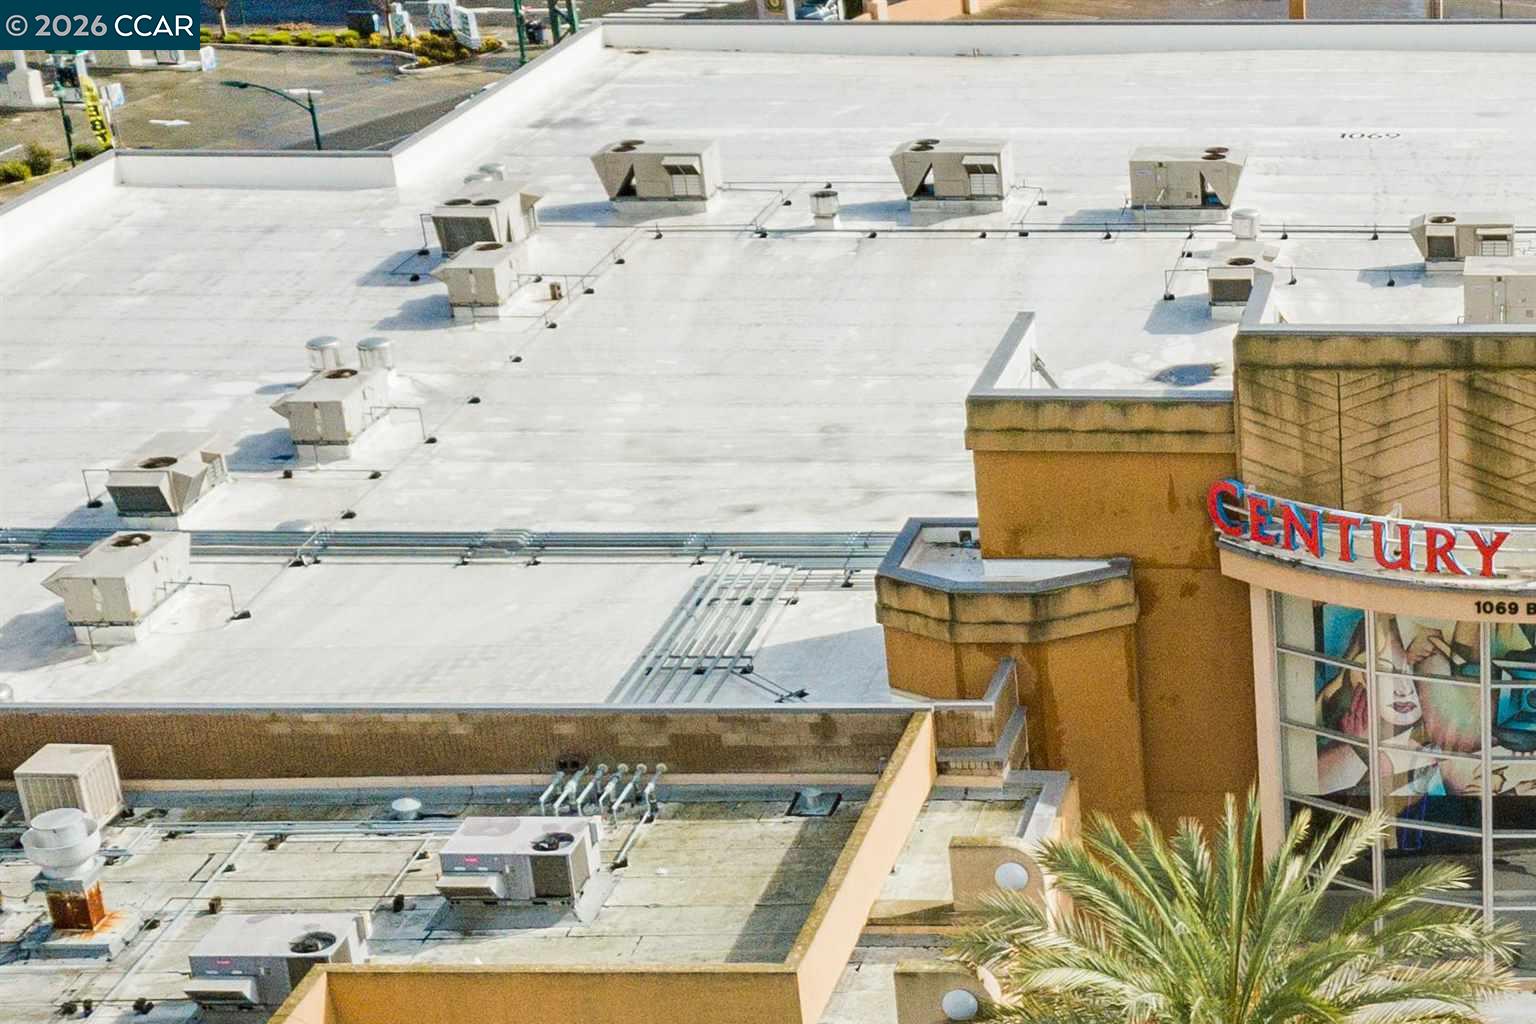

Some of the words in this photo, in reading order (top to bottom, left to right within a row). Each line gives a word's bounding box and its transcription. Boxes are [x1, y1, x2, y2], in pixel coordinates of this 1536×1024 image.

[1339, 131, 1401, 140] 1069
[1207, 478, 1511, 578] CENTURY
[1474, 600, 1519, 615] 1069
